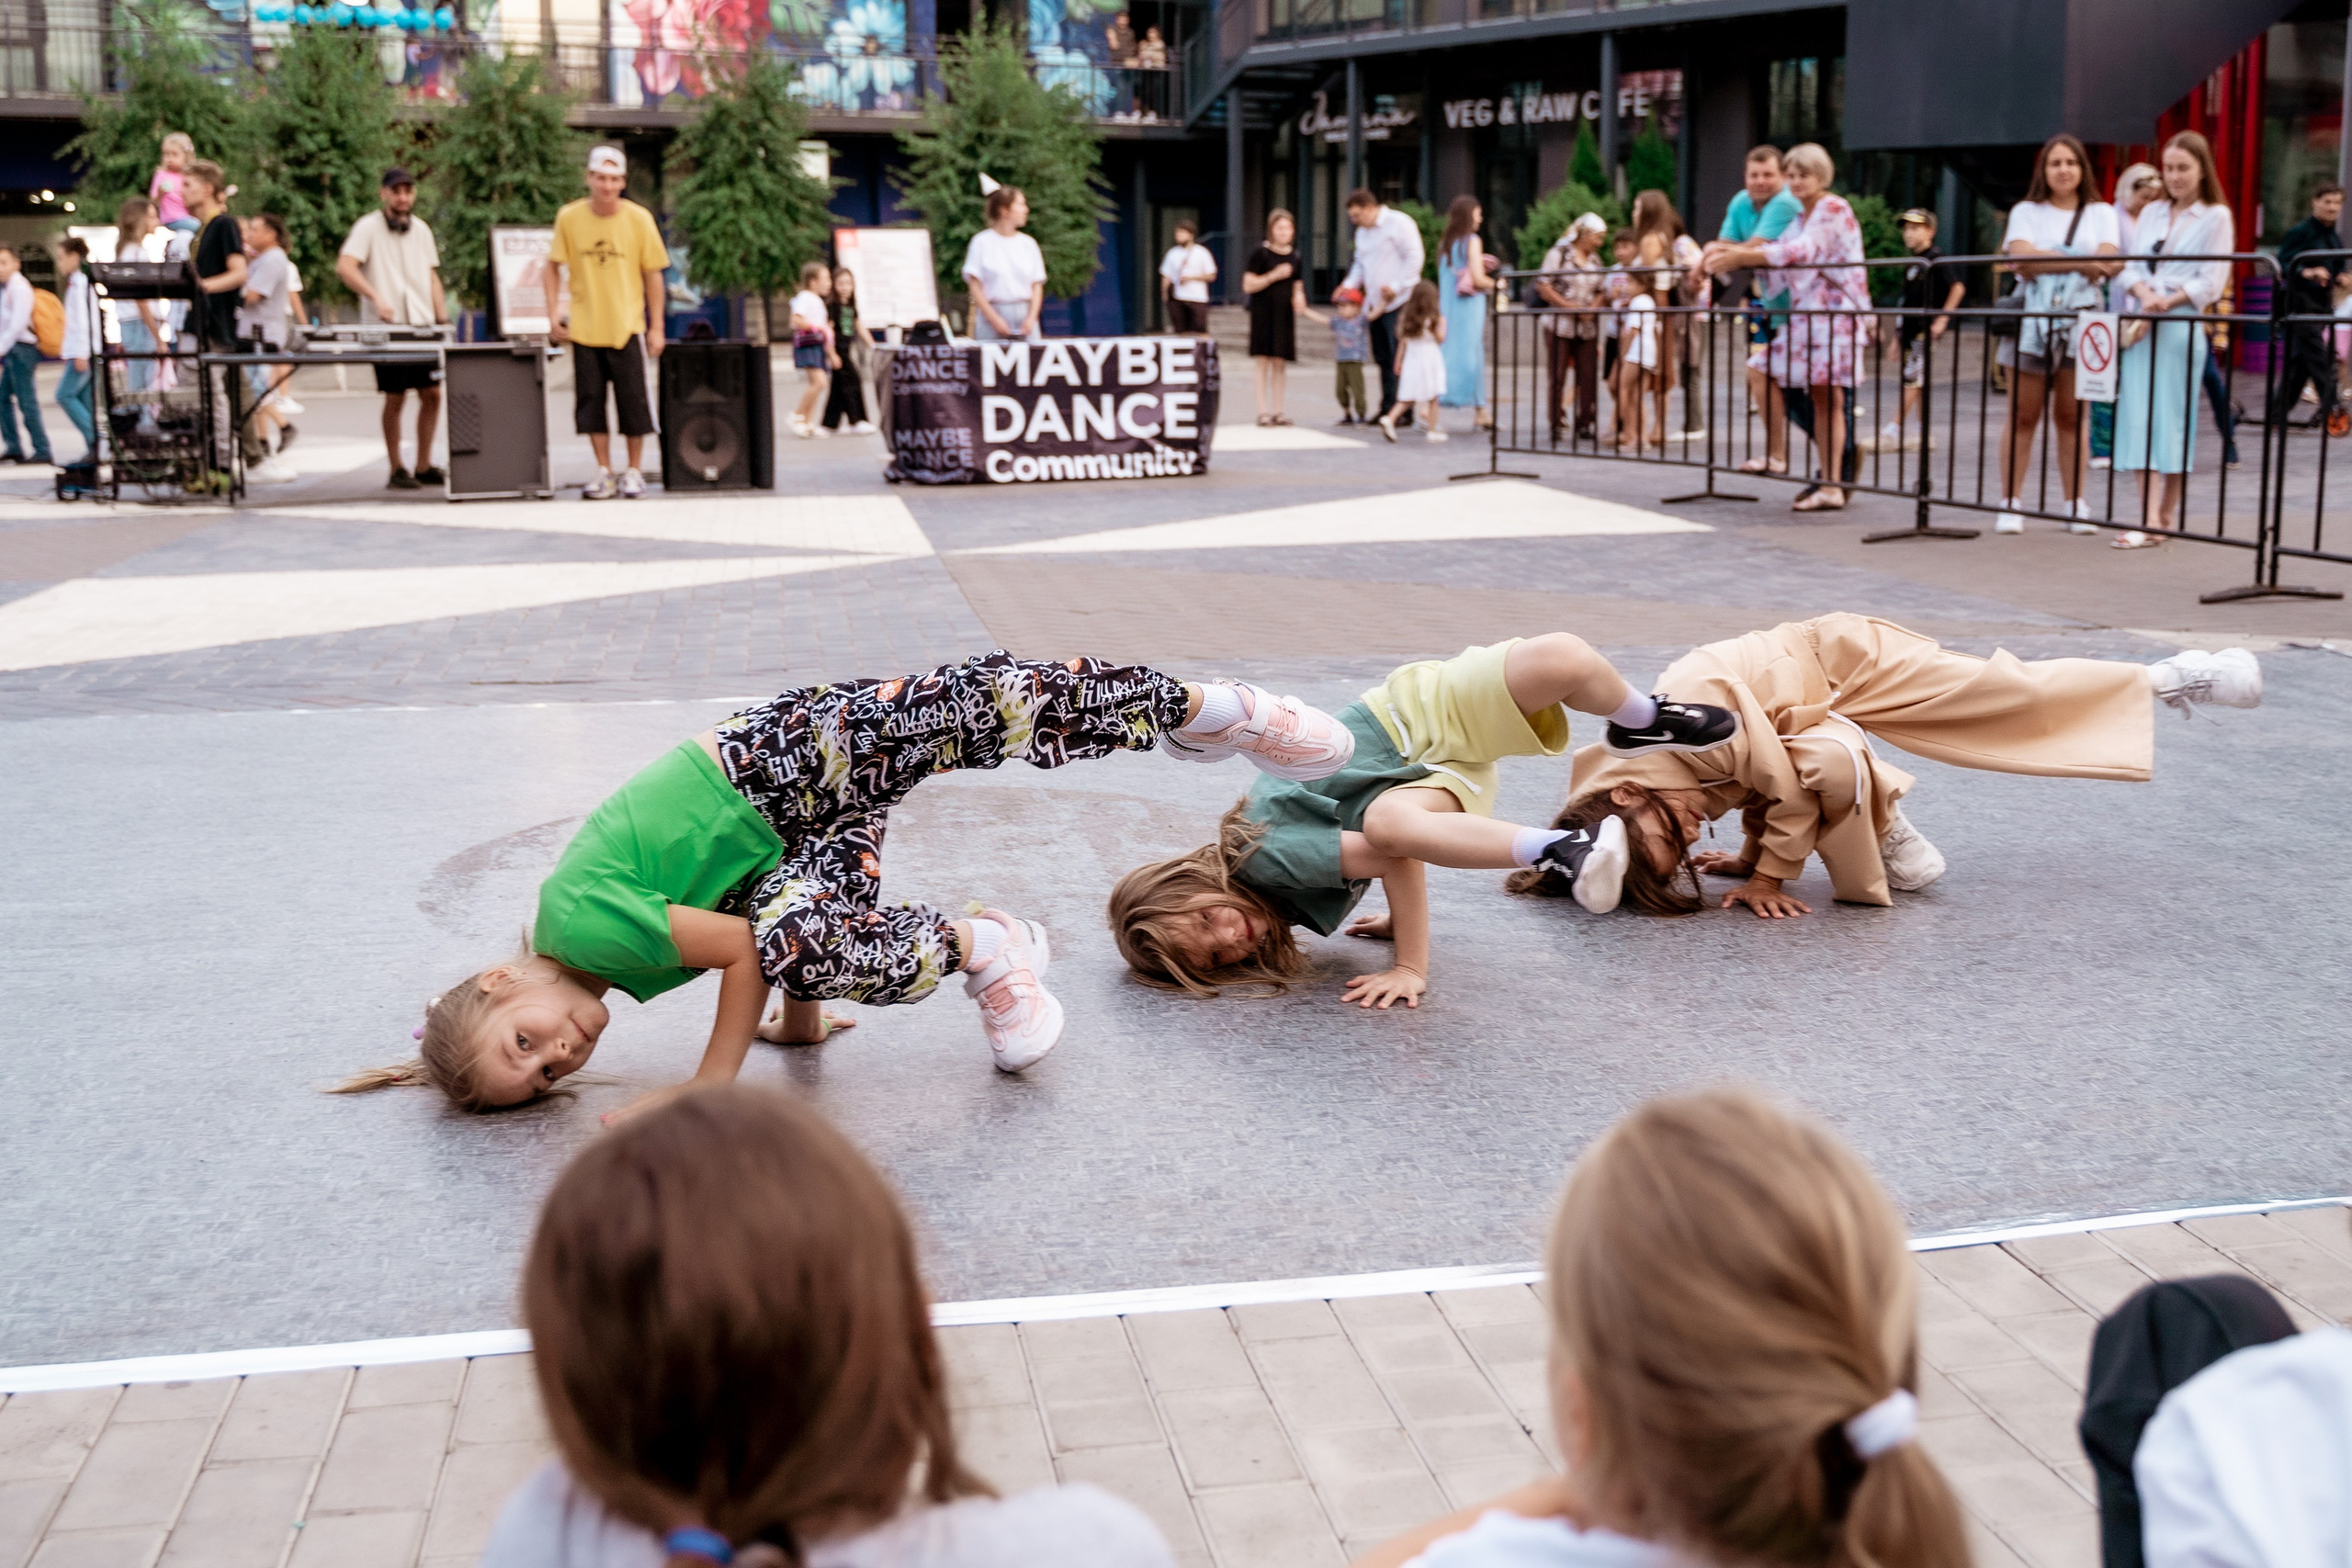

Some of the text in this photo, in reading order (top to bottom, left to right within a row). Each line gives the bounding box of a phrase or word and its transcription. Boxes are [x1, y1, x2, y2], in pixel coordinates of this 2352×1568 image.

[1443, 98, 1495, 129] VEG
[1498, 96, 1518, 126] &
[1521, 92, 1578, 125] RAW
[1580, 89, 1650, 120] CFE
[891, 359, 969, 380] DANCE
[980, 338, 1199, 387] MAYBE
[981, 392, 1198, 443] DANCE
[895, 427, 973, 448] MAYBE
[986, 445, 1196, 483] Community
